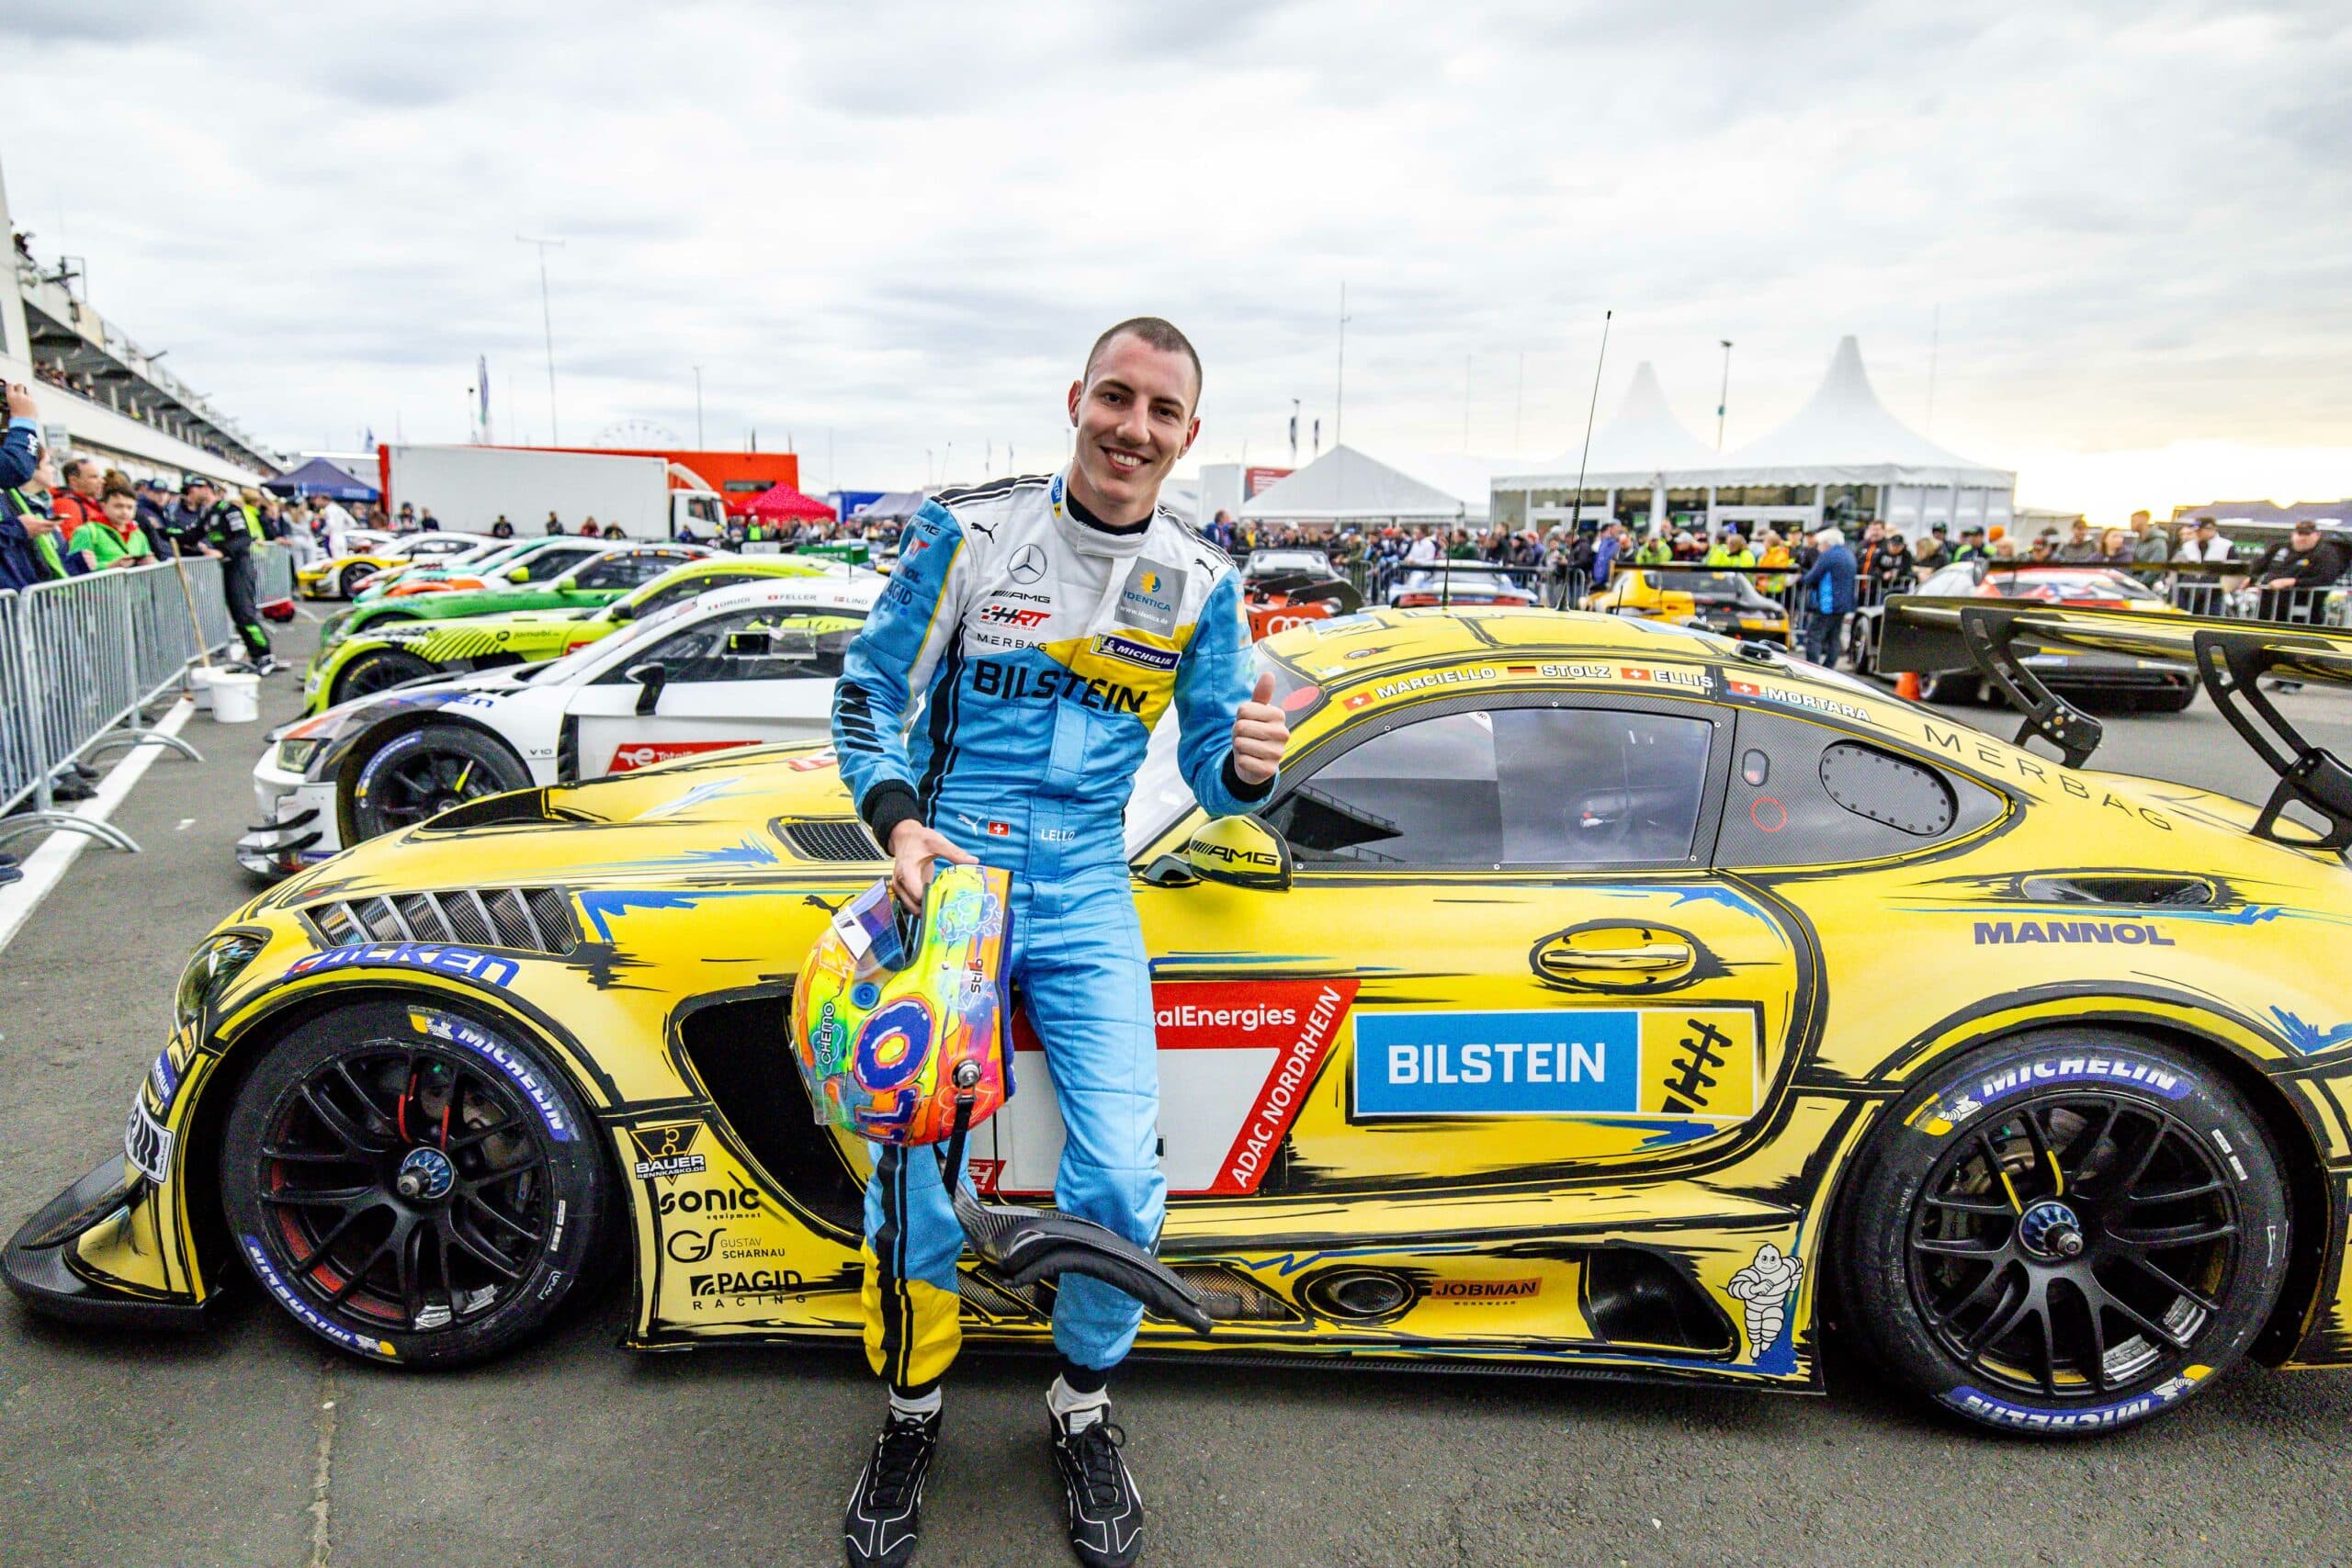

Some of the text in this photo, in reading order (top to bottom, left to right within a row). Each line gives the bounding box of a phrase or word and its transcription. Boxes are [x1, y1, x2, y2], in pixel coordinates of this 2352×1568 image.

[1123, 590, 1171, 612] IDENTICA
[977, 632, 1047, 652] MERBAG
[1116, 646, 1173, 665] MICHELIN
[1376, 667, 1497, 699] MARCIELLO
[1542, 665, 1611, 680] STOLZ
[1654, 671, 1714, 688] ELLIS
[972, 659, 1148, 715] BILSTEIN
[1766, 686, 1872, 723] MORTARA
[1924, 724, 2173, 831] MERBAG
[1040, 829, 1075, 841] LELLO
[1208, 845, 1278, 866] AMG
[1974, 921, 2176, 946] MANNOL
[283, 942, 520, 987] FALKEN
[1154, 1003, 1296, 1031] alEnergies
[1388, 1043, 1606, 1085] BILSTEIN
[458, 1027, 564, 1130] MICHELIN
[1230, 985, 1341, 1189] ADAC NORDRHEIN
[1982, 1057, 2177, 1098] MICHELIN
[636, 1155, 705, 1174] BAUER
[660, 1188, 760, 1215] sonic
[707, 1212, 761, 1221] equipment
[720, 1237, 763, 1248] GUSTAV
[722, 1248, 786, 1259] SCHARNAU
[718, 1269, 804, 1294] PAGID
[1435, 1281, 1536, 1296] JOBMAN
[694, 1295, 806, 1310] RACING
